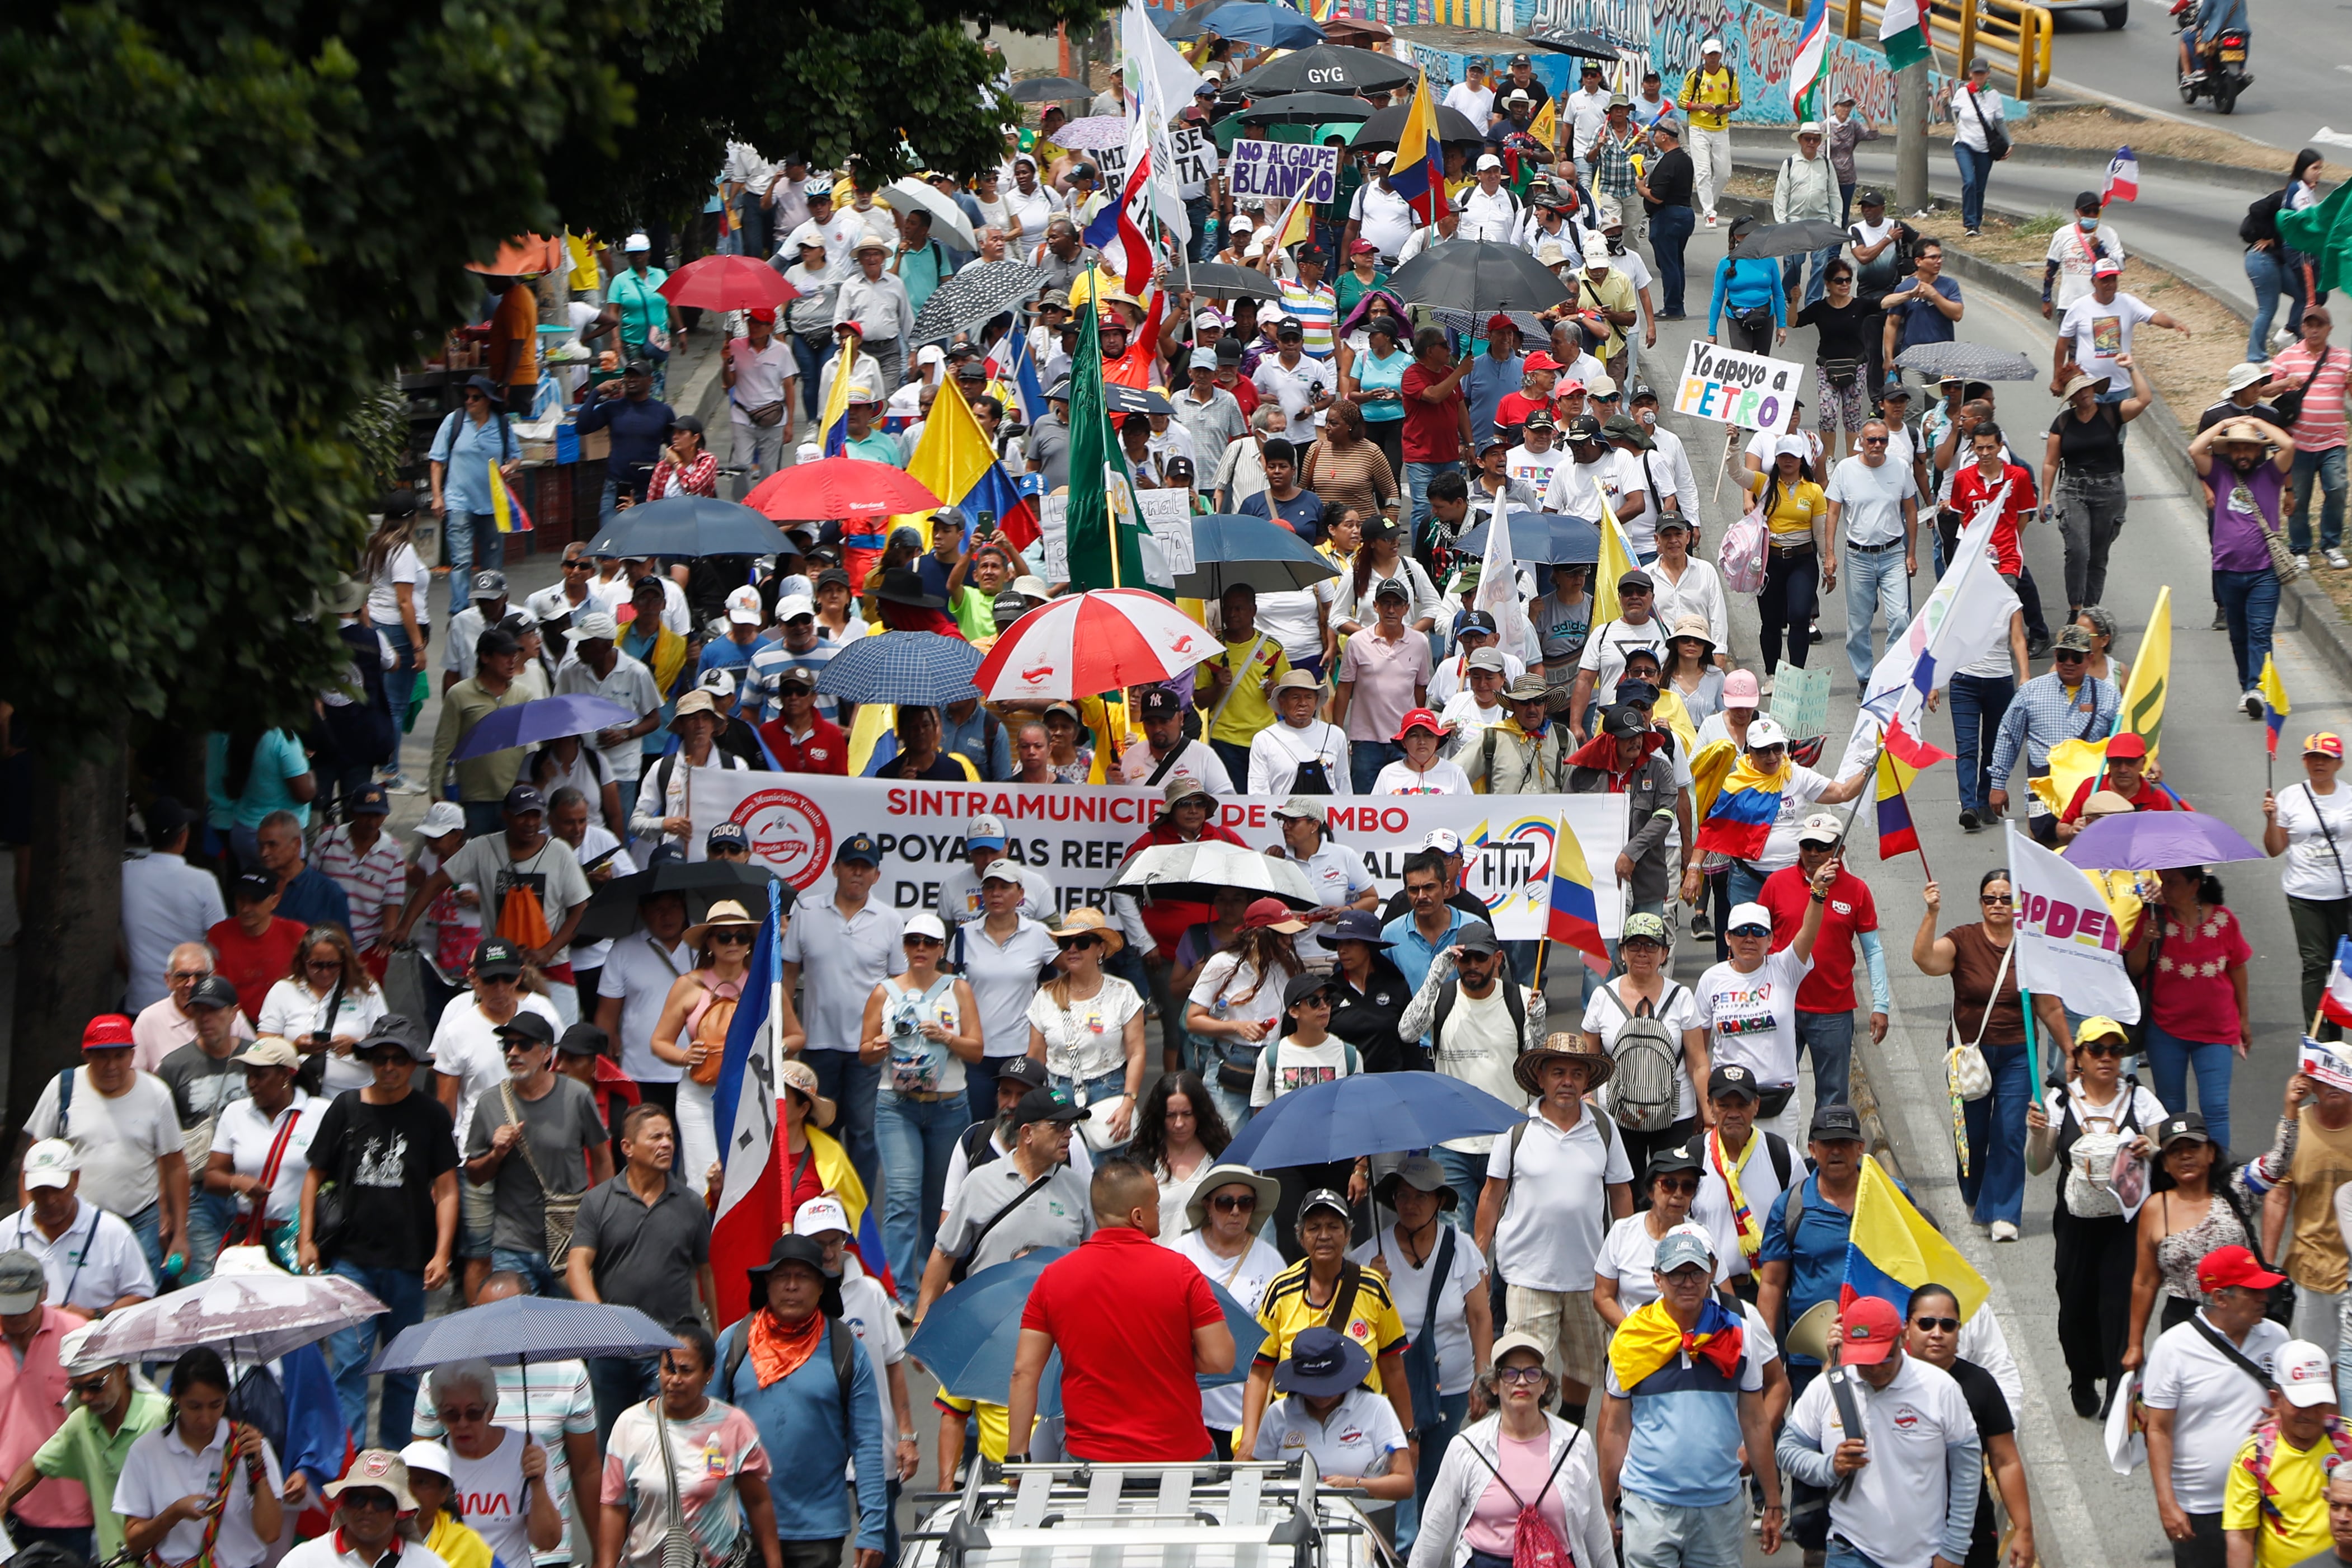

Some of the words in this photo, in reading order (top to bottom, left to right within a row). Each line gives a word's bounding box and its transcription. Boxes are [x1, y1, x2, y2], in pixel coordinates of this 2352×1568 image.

[1308, 67, 1344, 83] GYG
[1177, 130, 1203, 154] SE
[1236, 142, 1262, 162] NO
[1267, 143, 1285, 166] AL
[1287, 145, 1336, 171] GOLPE
[1233, 162, 1334, 201] BLANDO
[1693, 343, 1713, 377] Yo
[1713, 356, 1766, 389] apoyo
[1772, 370, 1788, 392] a
[1679, 378, 1779, 426] PETRO
[1513, 465, 1553, 480] PETRO
[1552, 621, 1586, 632] adida
[752, 793, 796, 808] Municipio
[799, 799, 822, 827] Yumbo
[1221, 804, 1266, 828] DE
[712, 824, 741, 838] COCO
[859, 833, 972, 863] POYA
[1481, 842, 1536, 892] CUT
[1712, 989, 1758, 1006] PETRO
